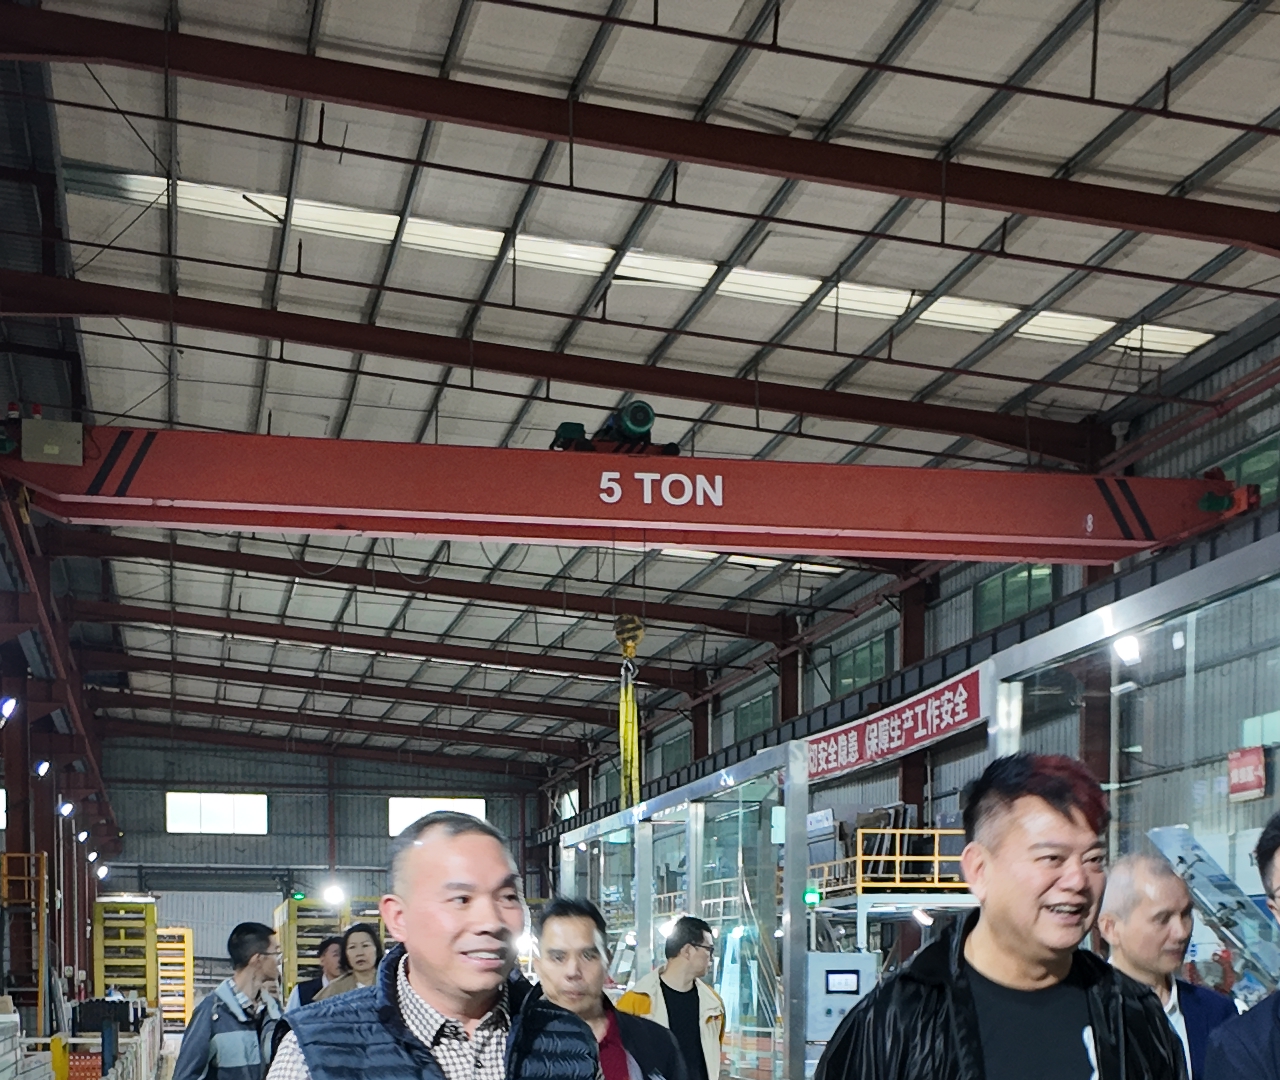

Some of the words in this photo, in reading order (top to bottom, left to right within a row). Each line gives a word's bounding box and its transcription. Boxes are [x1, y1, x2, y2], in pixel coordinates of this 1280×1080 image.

[599, 471, 622, 503] 5
[634, 472, 723, 506] TON
[864, 682, 969, 759] 保障生产工作安全
